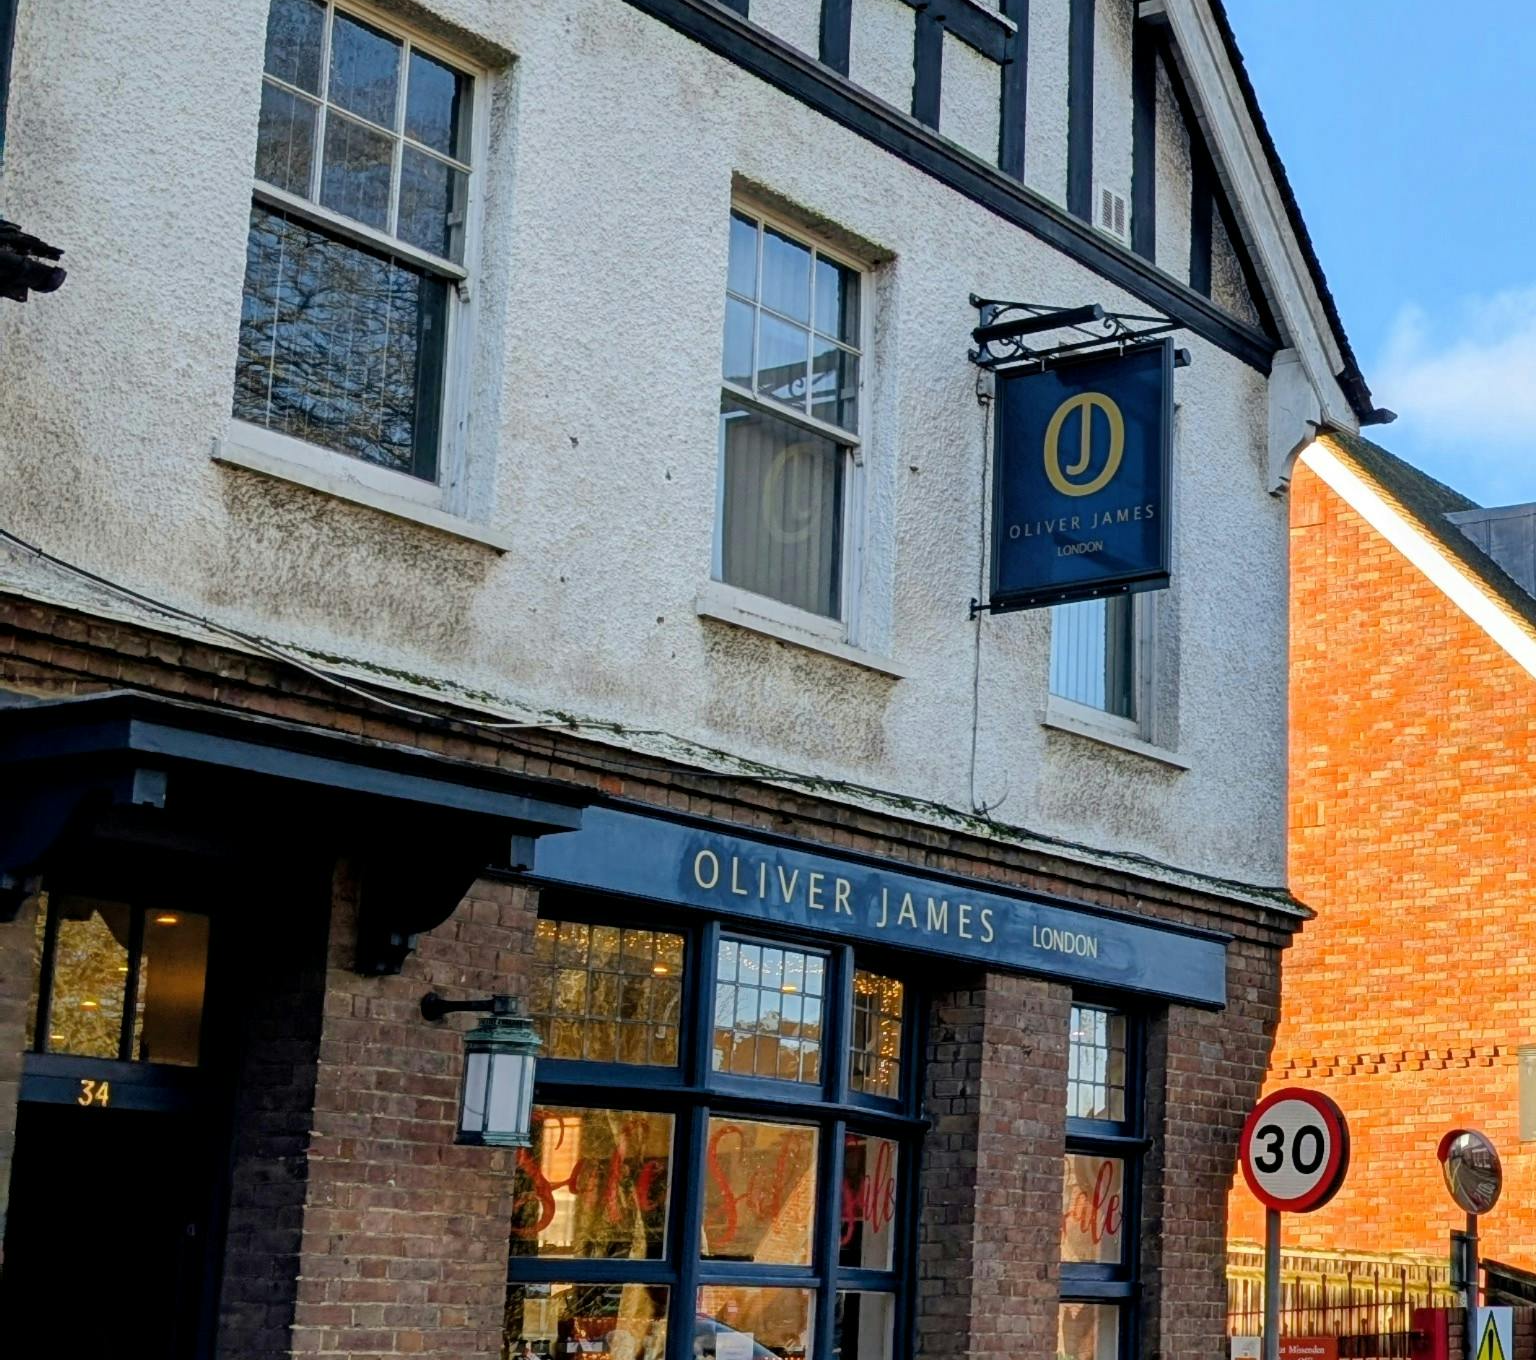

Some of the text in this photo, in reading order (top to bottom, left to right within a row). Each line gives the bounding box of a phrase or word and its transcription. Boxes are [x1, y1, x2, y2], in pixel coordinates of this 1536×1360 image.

[1009, 504, 1155, 540] OLIVER JAMES
[1057, 541, 1104, 557] LONDON
[693, 849, 1098, 959] OLIVER JAMES LONDON
[78, 1079, 109, 1107] 34
[1254, 1124, 1325, 1175] 30
[1289, 1344, 1325, 1354] Missenden
